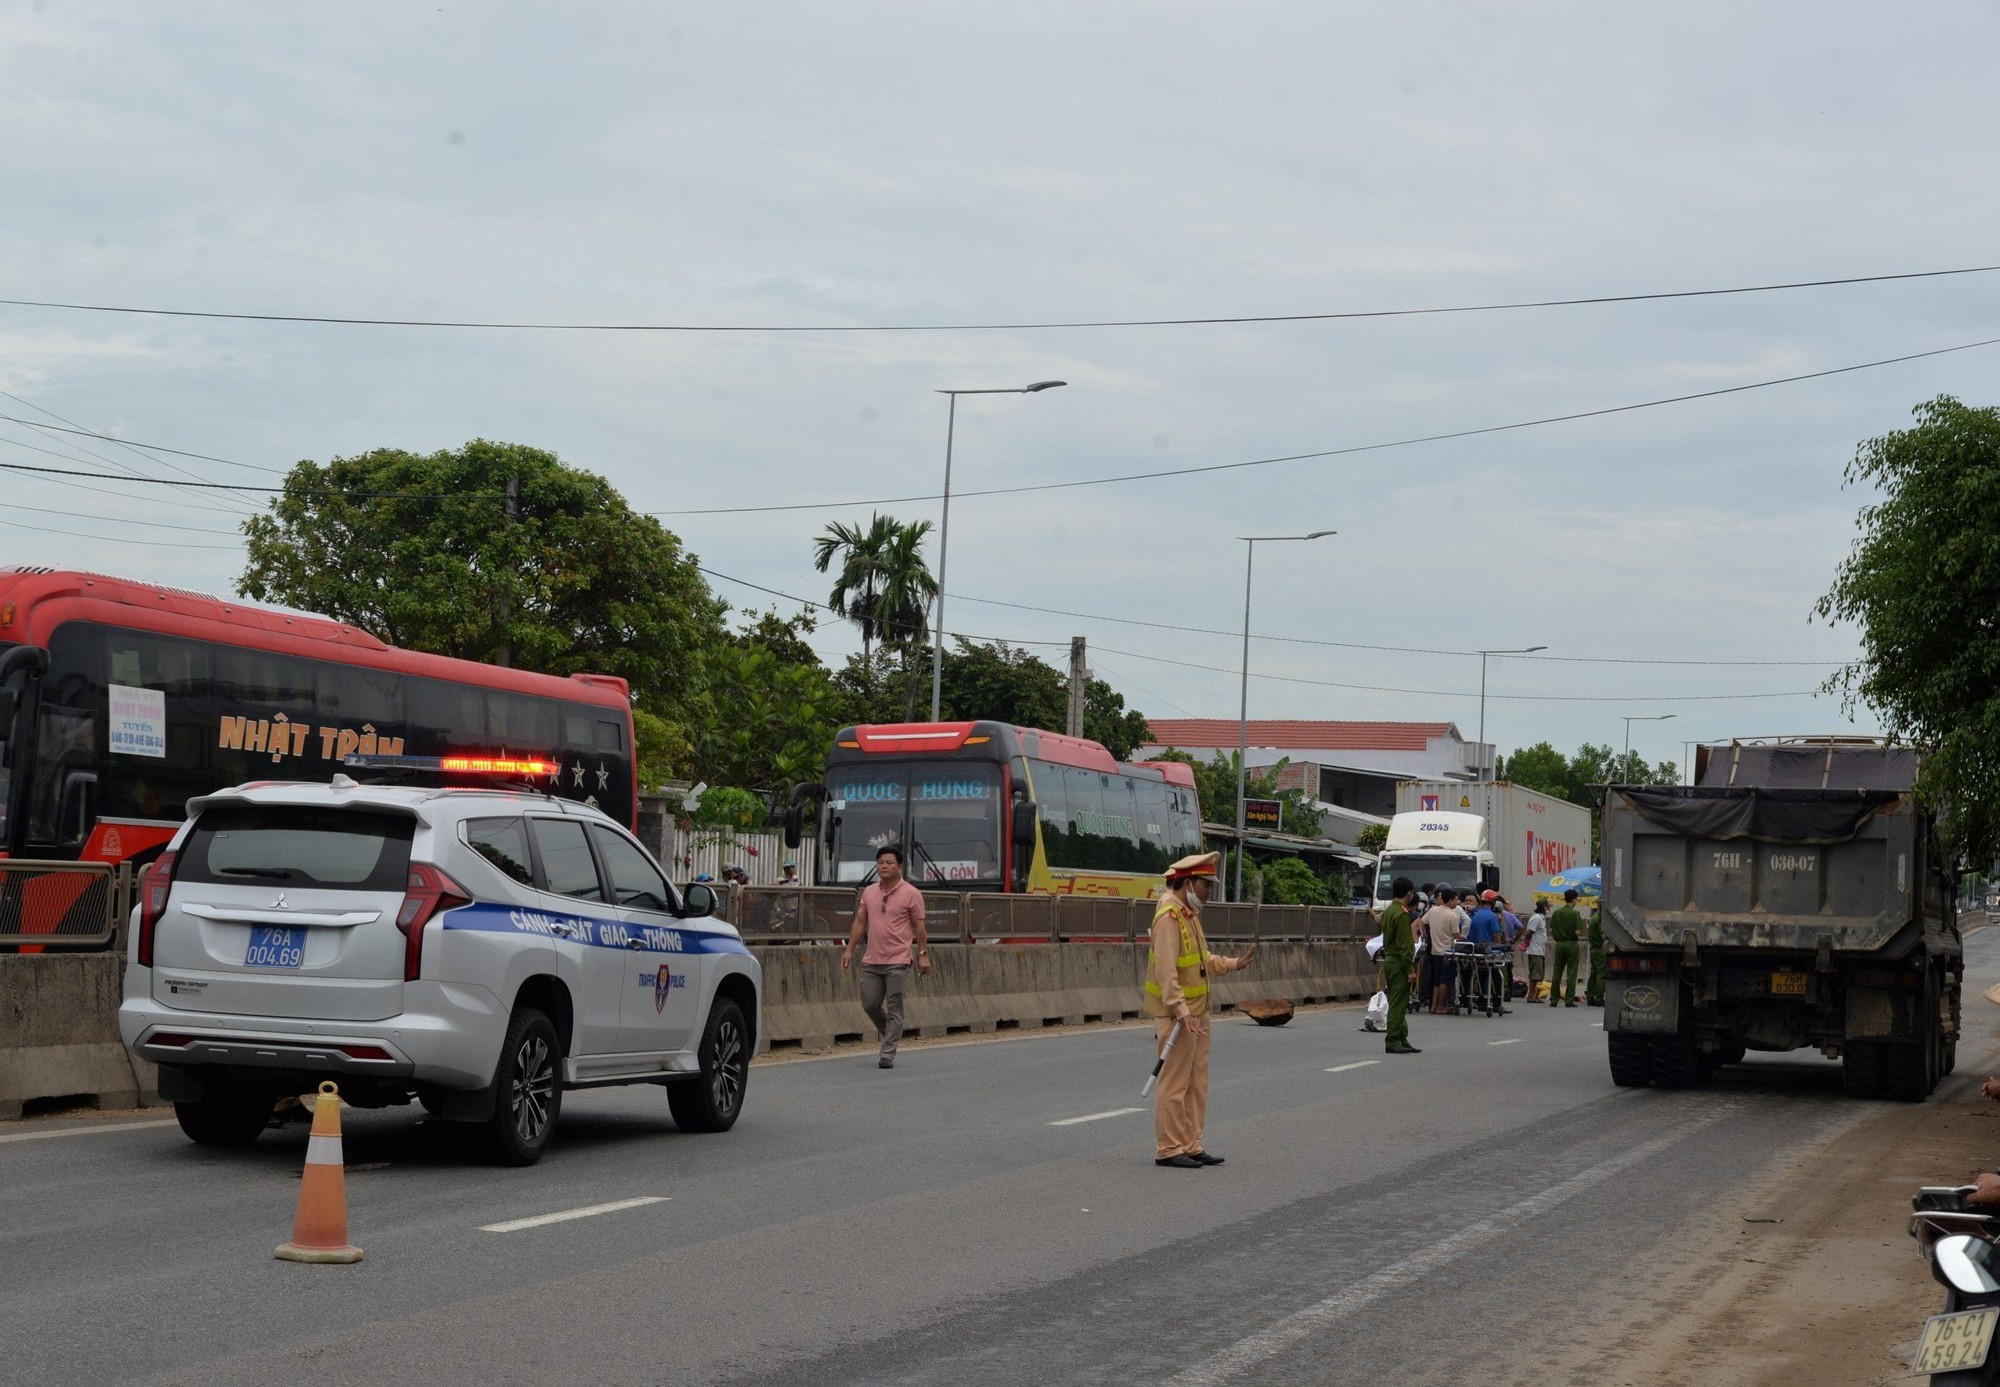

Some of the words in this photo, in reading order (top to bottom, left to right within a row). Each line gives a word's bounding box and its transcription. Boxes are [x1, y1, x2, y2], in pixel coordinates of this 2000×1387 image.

[219, 712, 310, 763] NHẬT
[319, 723, 405, 762] TRÂM
[1420, 823, 1449, 832] 20345
[1714, 852, 1740, 868] 76H
[950, 863, 975, 880] GÒN
[261, 927, 291, 947] 76A
[510, 908, 554, 934] CẢNH
[568, 917, 593, 943] SÁT
[600, 924, 627, 947] GIAO
[643, 927, 683, 952] THÔNG
[247, 946, 300, 966] 004.69
[638, 973, 655, 987] TRAFFIC
[670, 975, 685, 988] POLICE
[1918, 1339, 1983, 1370] 459.24
